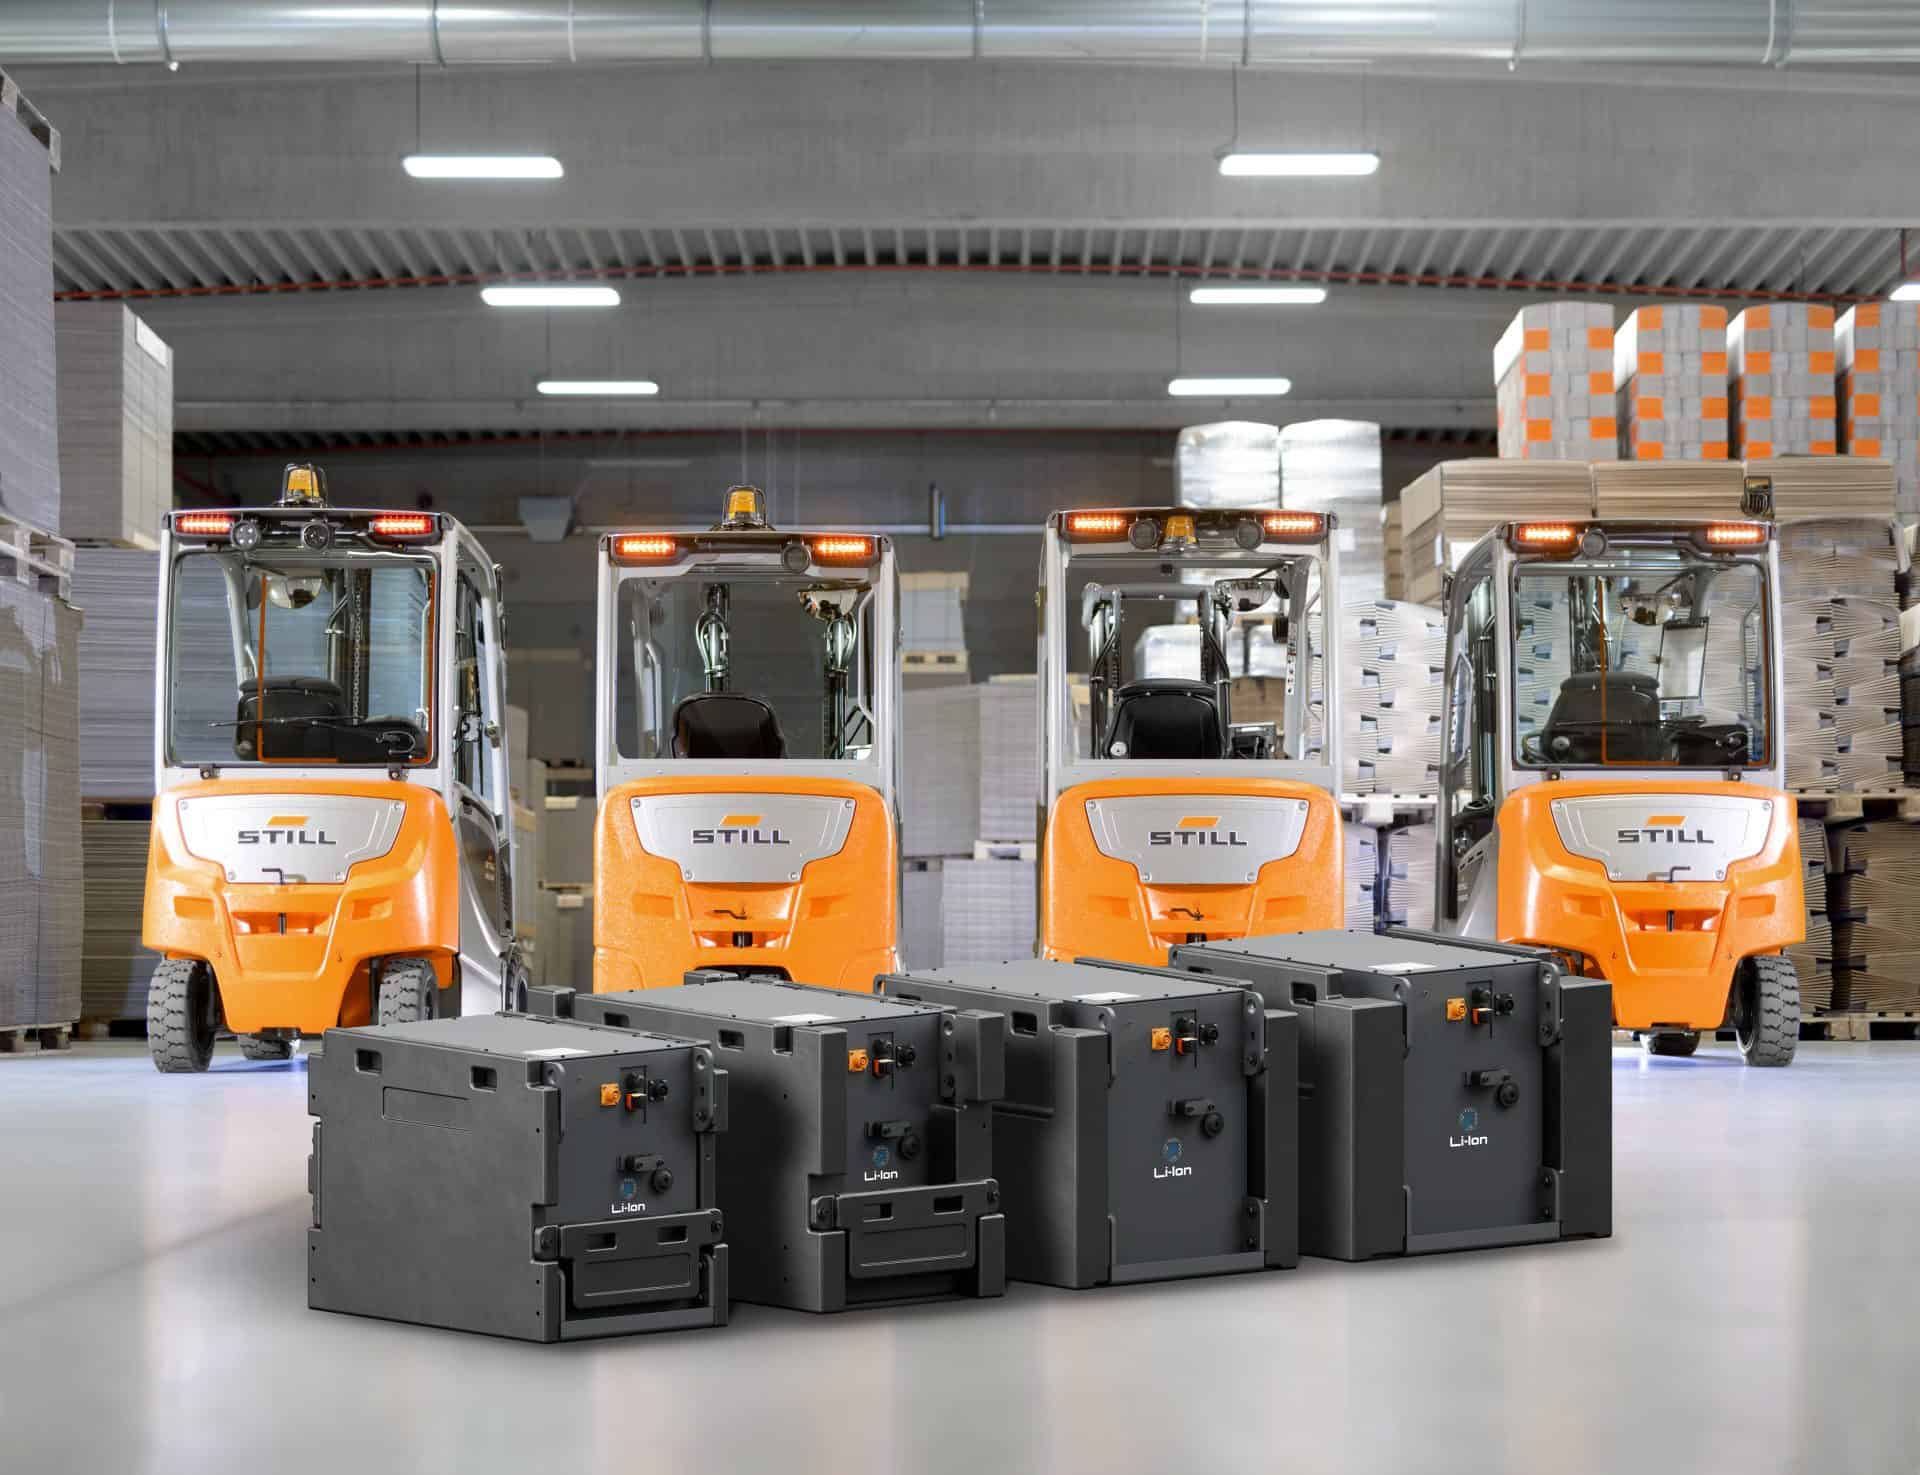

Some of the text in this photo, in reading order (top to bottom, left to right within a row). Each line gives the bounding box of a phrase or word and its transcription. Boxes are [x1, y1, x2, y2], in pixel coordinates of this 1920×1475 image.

[238, 830, 336, 845] STILL
[692, 829, 790, 845] STILL
[1150, 831, 1247, 846] STILL
[1617, 829, 1714, 844] STILL
